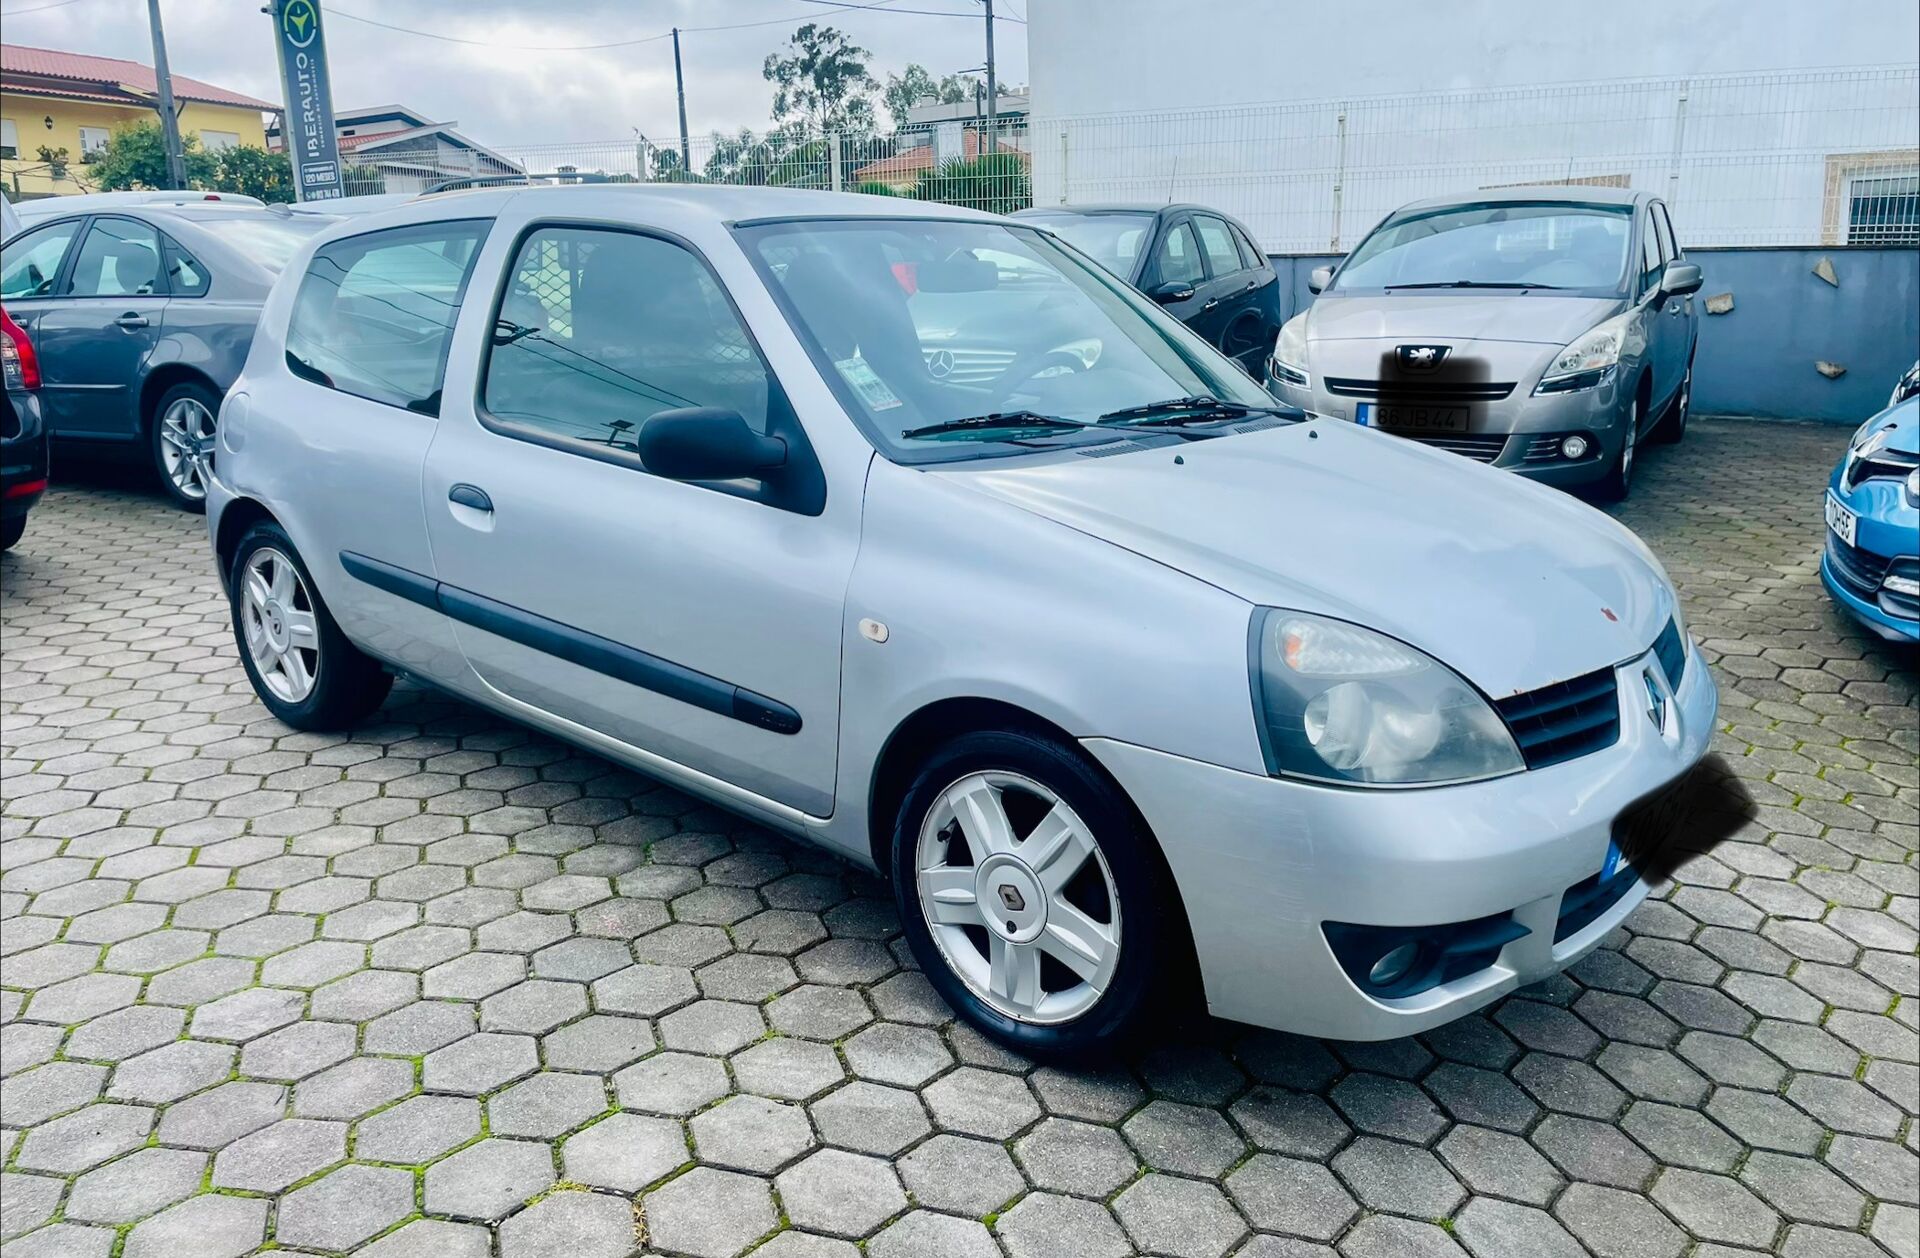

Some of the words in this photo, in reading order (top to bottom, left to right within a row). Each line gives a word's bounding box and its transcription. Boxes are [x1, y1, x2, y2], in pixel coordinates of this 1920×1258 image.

[296, 52, 320, 157] IBERAUTO
[1377, 408, 1400, 426] 86
[1404, 409, 1428, 427] JB
[1431, 411, 1456, 428] 44
